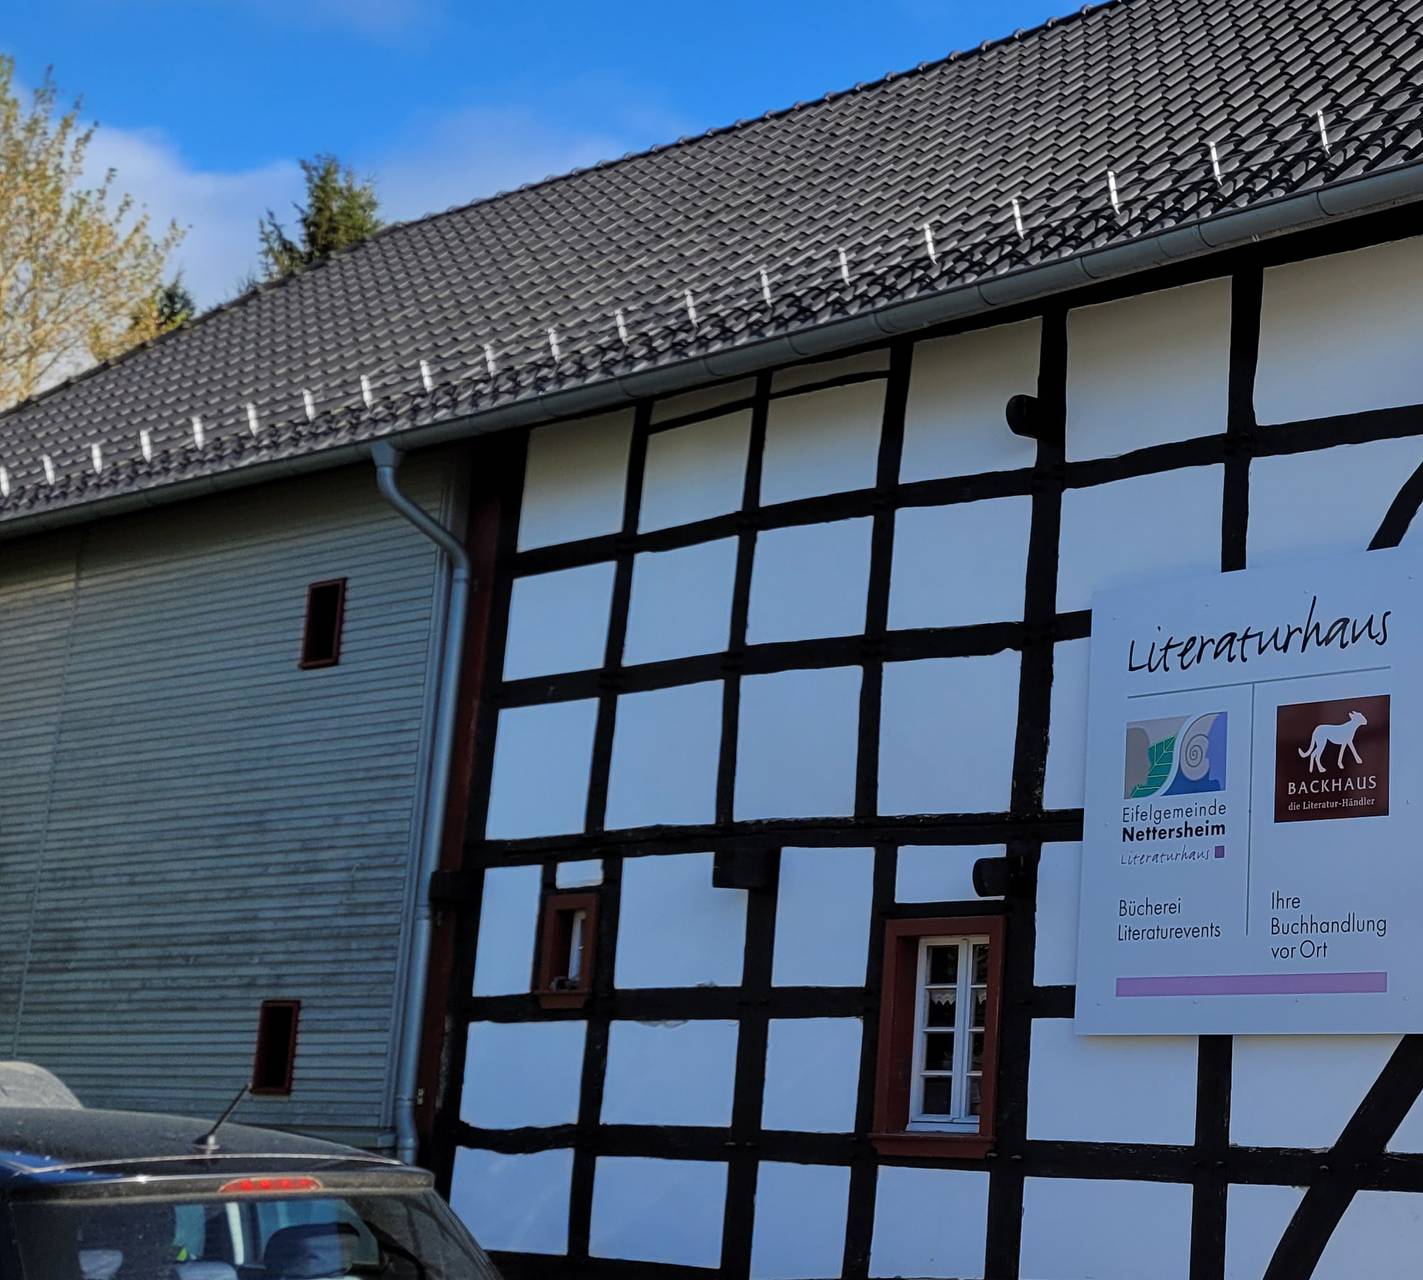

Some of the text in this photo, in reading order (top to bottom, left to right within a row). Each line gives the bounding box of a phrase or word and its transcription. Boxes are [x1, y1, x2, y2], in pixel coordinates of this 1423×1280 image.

[1127, 596, 1392, 673] Literaturhaus
[1288, 775, 1377, 795] BACKHAUS
[1122, 798, 1227, 825] Eifelgemeinde
[1288, 797, 1376, 811] die Literatur-Händler
[1122, 819, 1226, 843] Nettersheim
[1120, 844, 1210, 866] Literaturhaus
[1118, 897, 1182, 918] Bücherei
[1271, 890, 1301, 910] Ihre
[1117, 921, 1222, 942] Literaturevents
[1271, 912, 1387, 938] Buchhandlung
[1271, 940, 1328, 960] vor Ort
